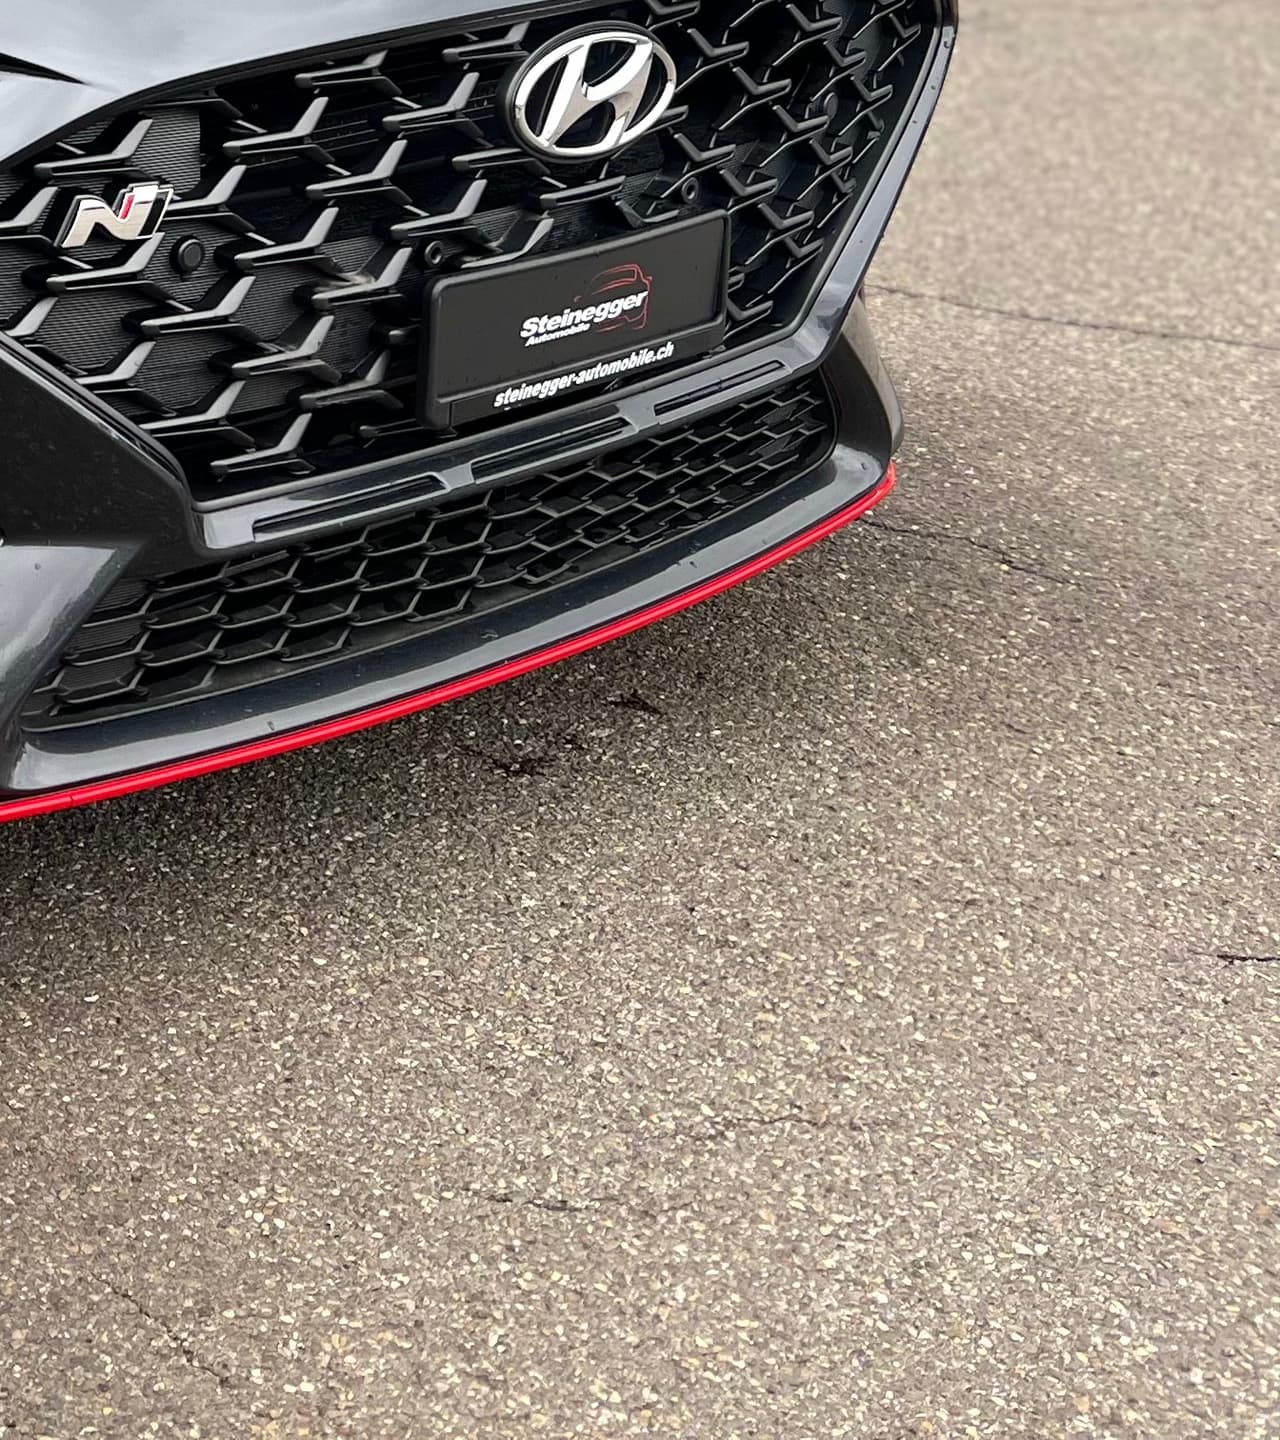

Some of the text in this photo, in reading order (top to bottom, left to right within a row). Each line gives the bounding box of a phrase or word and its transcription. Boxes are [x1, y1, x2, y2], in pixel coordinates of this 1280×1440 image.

[520, 290, 649, 338] Steinegger
[525, 323, 591, 347] Automobile
[493, 341, 675, 408] steinegger-automobile.ch
